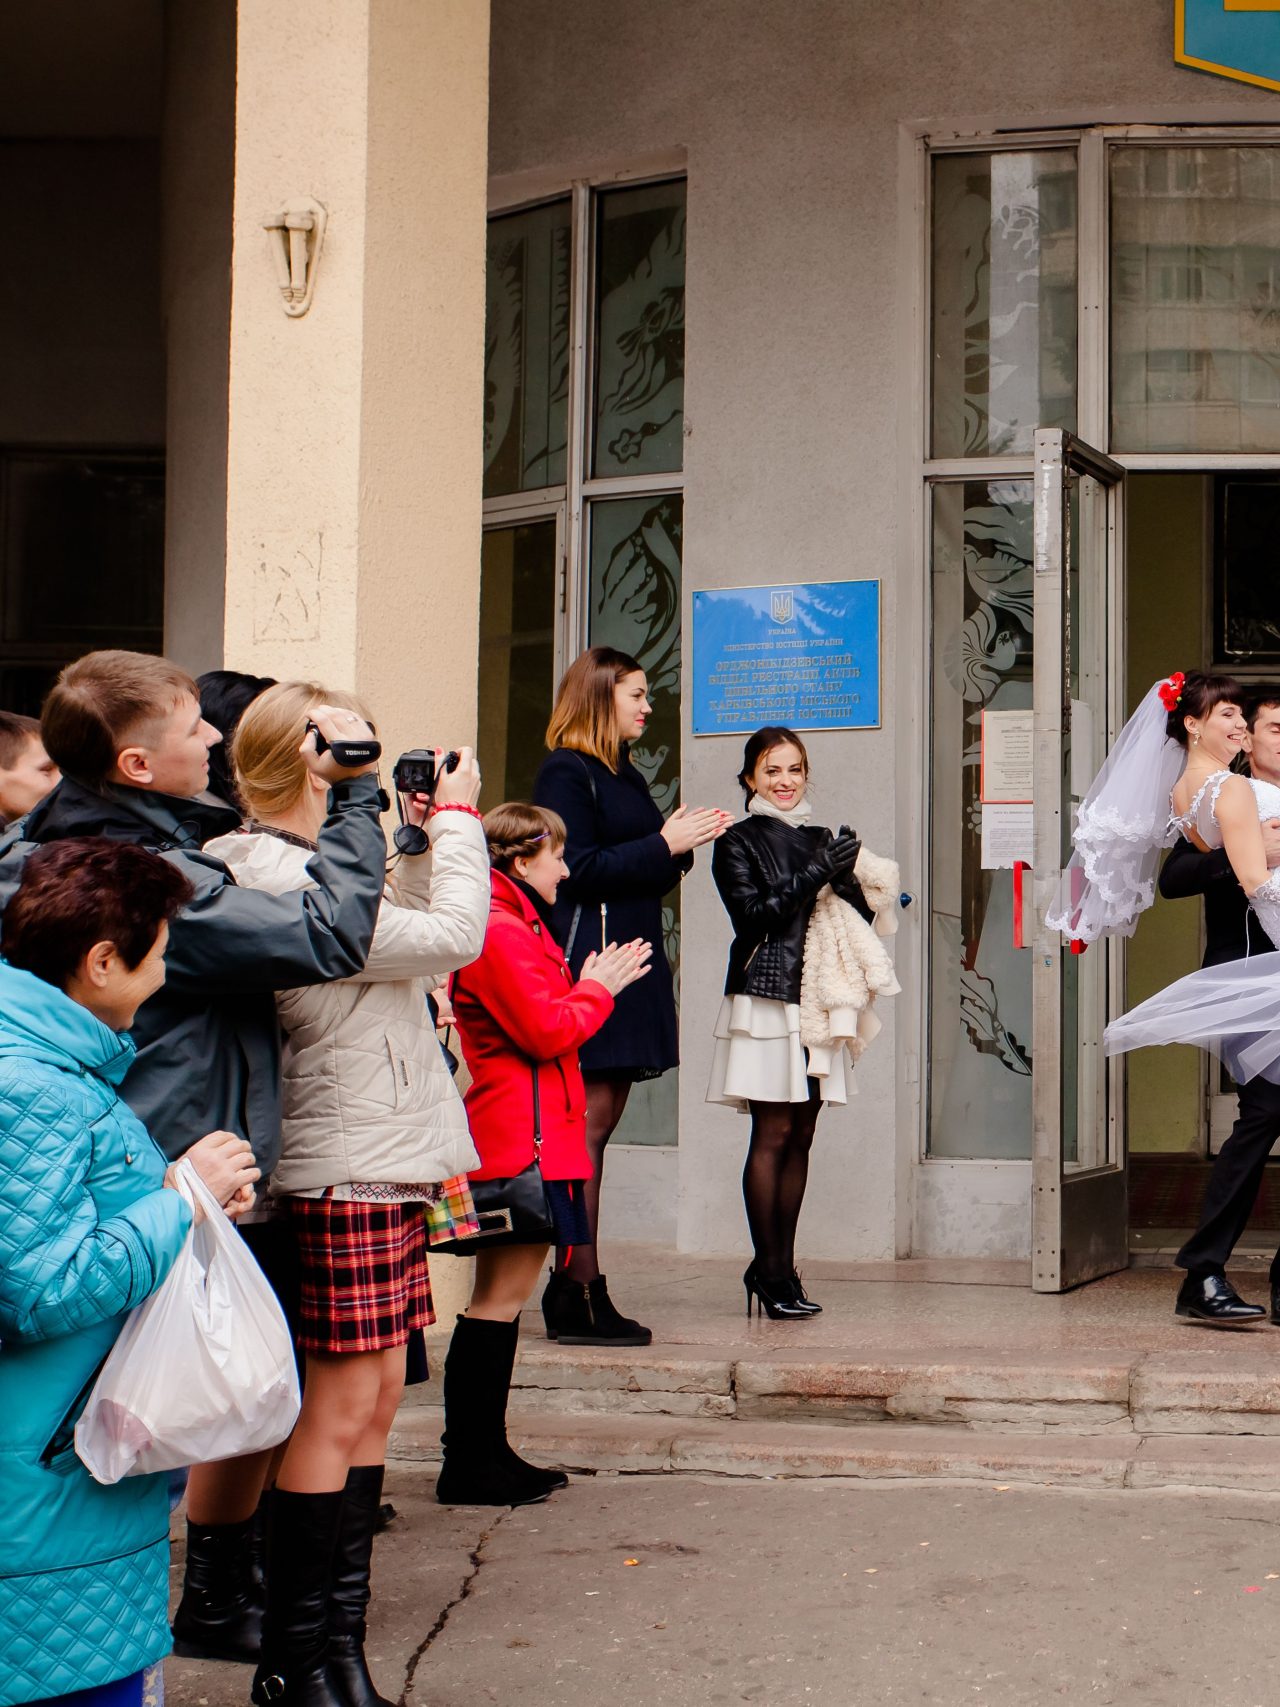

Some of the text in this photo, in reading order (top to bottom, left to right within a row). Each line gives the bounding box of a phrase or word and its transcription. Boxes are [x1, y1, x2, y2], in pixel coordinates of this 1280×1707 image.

[752, 669, 819, 682] РЕЄСТРАЦІЇ
[824, 667, 860, 680] АКТІВ
[802, 681, 843, 693] СТАНУ
[800, 693, 860, 706] МІСЬКОГО
